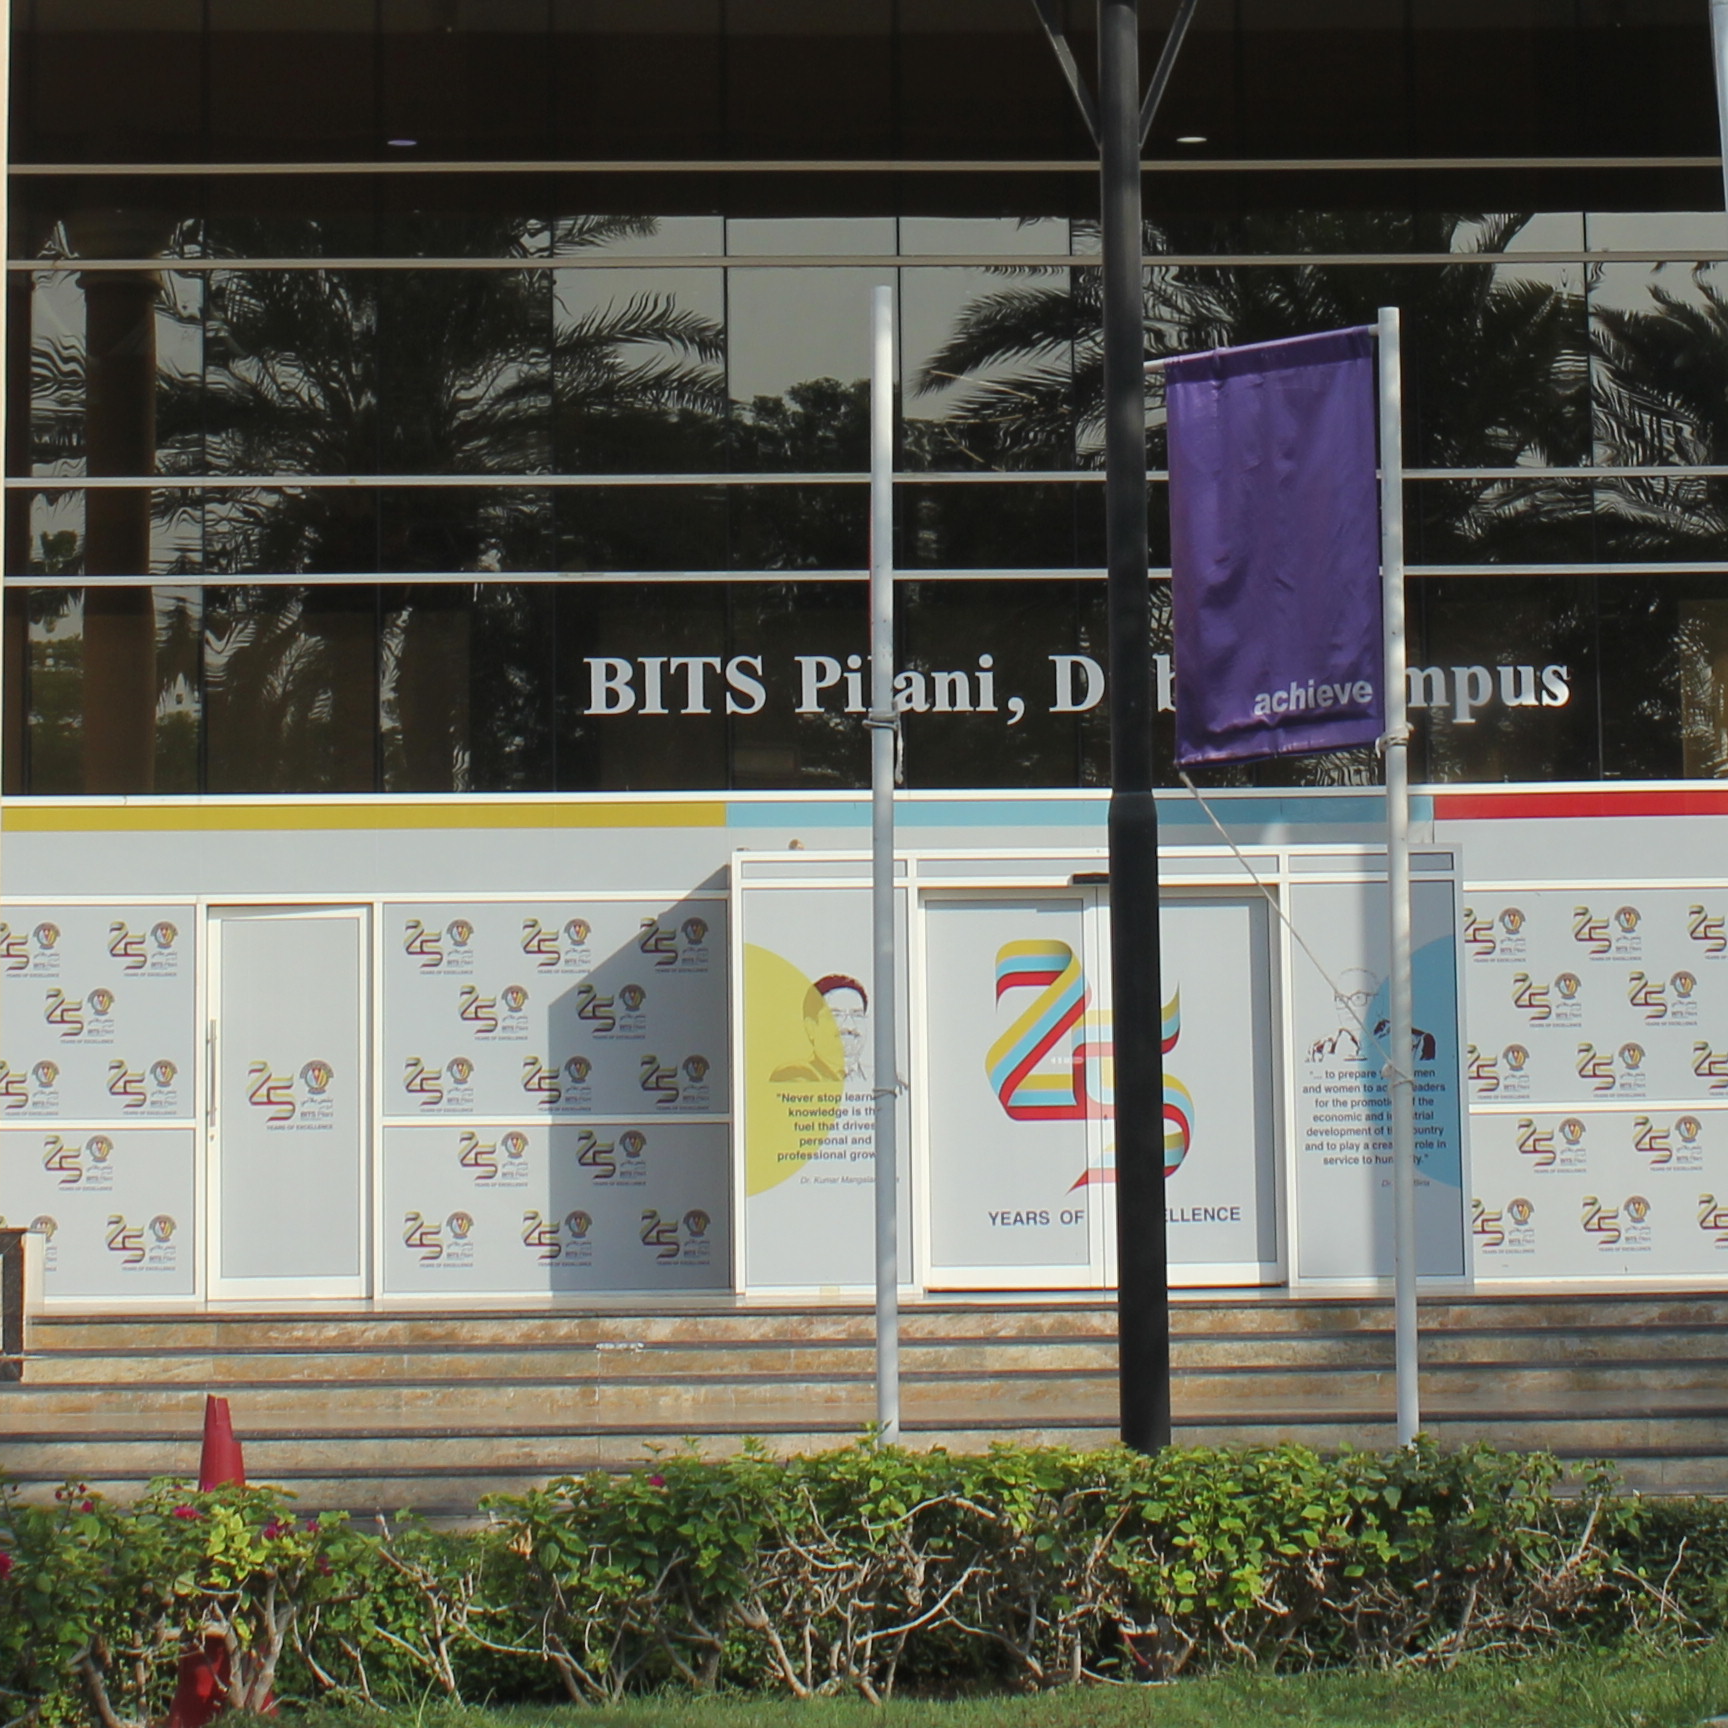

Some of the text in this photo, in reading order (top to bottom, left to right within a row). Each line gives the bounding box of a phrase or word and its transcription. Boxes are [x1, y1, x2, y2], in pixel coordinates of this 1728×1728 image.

[583, 655, 767, 715] BITS
[1405, 664, 1571, 723] mpus
[1254, 678, 1373, 716] achieve
[1325, 1070, 1335, 1079] to
[1338, 1070, 1377, 1081] prepare
[1303, 1084, 1321, 1094] and
[1324, 1084, 1361, 1093] women
[1364, 1083, 1373, 1092] to
[1412, 1083, 1446, 1092] eaders
[817, 1092, 842, 1105] stop
[1315, 1098, 1328, 1108] for
[1332, 1098, 1348, 1108] the
[1350, 1098, 1392, 1109] promoti
[1418, 1097, 1434, 1106] the
[788, 1106, 849, 1118] knowledge
[852, 1106, 862, 1116] is
[1313, 1112, 1362, 1122] economic
[1365, 1112, 1384, 1121] and
[794, 1121, 815, 1131] fuel
[818, 1121, 839, 1131] that
[1306, 1126, 1372, 1137] development
[1374, 1126, 1384, 1135] of
[1413, 1126, 1444, 1137] ountry
[799, 1135, 872, 1148] personal and
[1305, 1141, 1323, 1151] and
[1326, 1142, 1336, 1151] to
[1339, 1141, 1360, 1152] play
[1363, 1142, 1370, 1150] a
[1415, 1139, 1434, 1149] role
[1437, 1139, 1447, 1148] in
[777, 1149, 877, 1162] professional grow
[1323, 1155, 1359, 1165] service
[1362, 1155, 1373, 1164] to
[988, 1206, 1241, 1226] YEARS OF LLENCE
